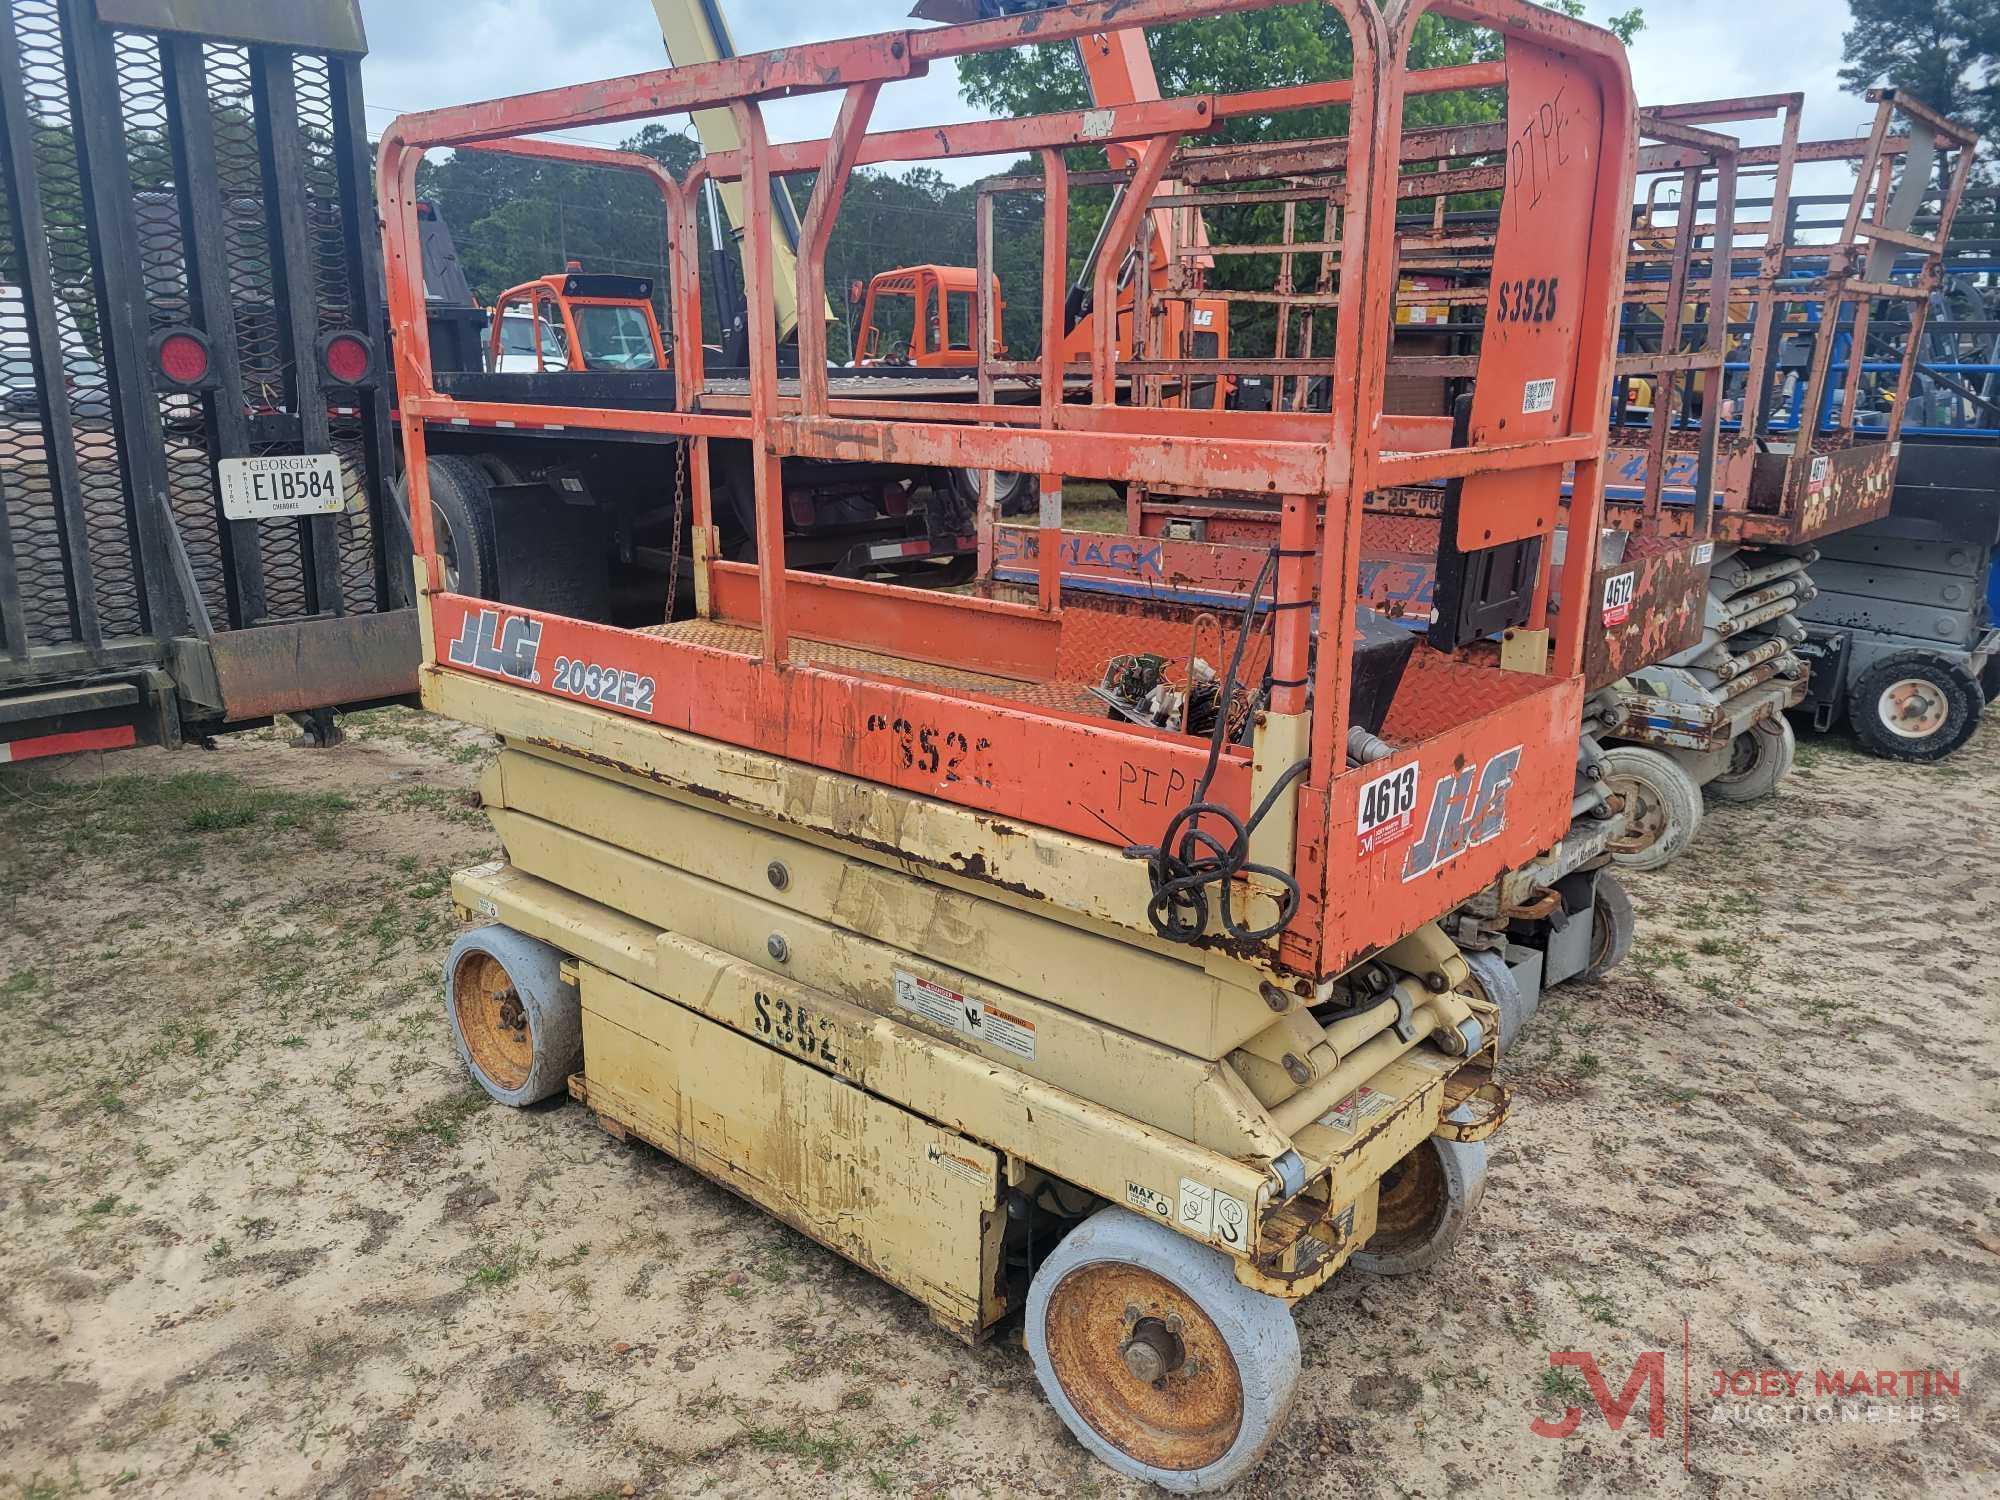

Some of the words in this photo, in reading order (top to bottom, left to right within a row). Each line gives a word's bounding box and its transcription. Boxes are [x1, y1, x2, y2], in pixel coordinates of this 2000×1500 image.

[1497, 278, 1559, 324] S3525
[1193, 309, 1214, 326] LG
[249, 458, 314, 471] GEORGIA
[272, 502, 299, 511] CHEROKEE
[1606, 576, 1632, 606] 4612
[448, 609, 543, 682] JLG
[552, 655, 656, 714] 2032E2
[1362, 767, 1415, 828] 4613
[1128, 1183, 1154, 1201] MAX
